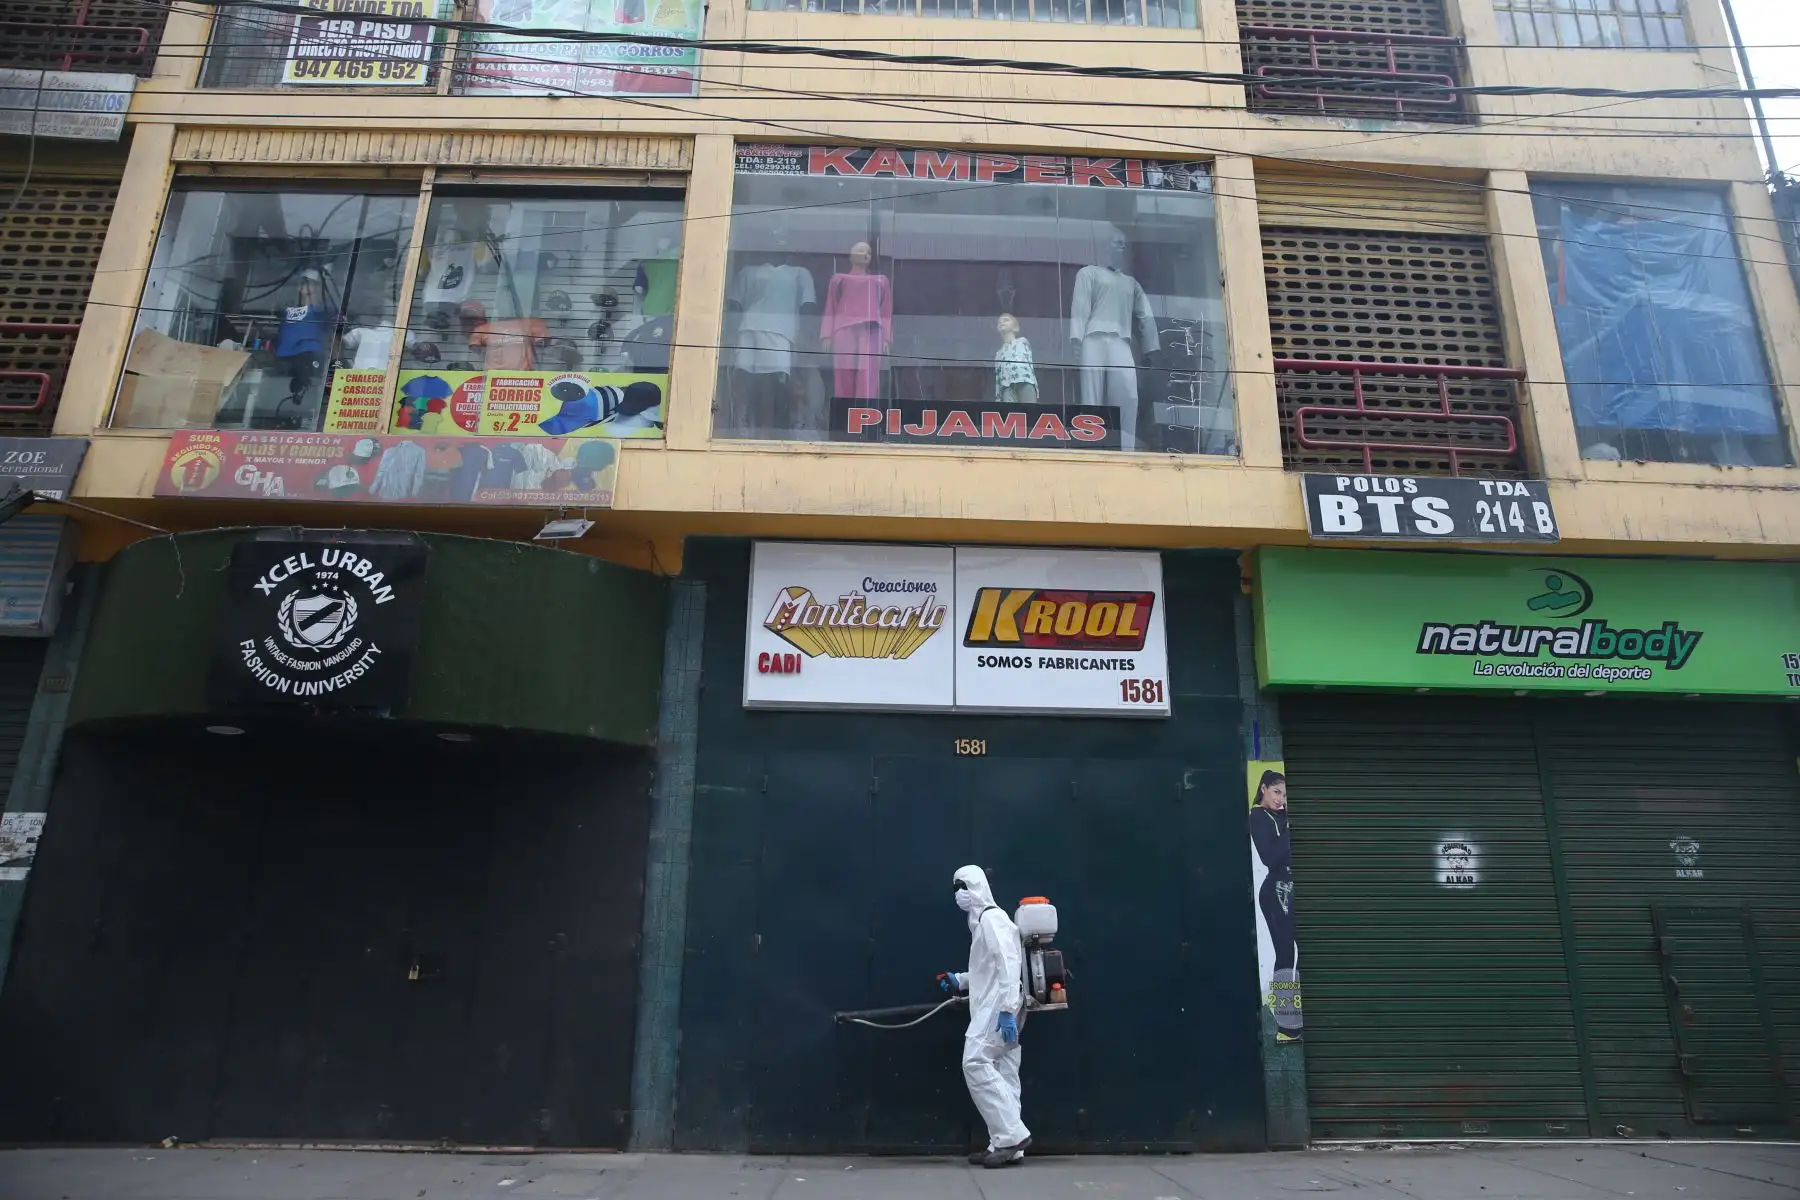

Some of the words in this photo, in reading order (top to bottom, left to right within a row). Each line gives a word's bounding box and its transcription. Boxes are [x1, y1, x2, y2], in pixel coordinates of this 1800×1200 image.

[333, 0, 386, 14] VENDE
[318, 20, 356, 38] 1ER
[298, 38, 346, 58] DIRECTO
[348, 40, 422, 59] PROPIETARIO
[616, 44, 685, 58] GORROS
[294, 60, 331, 78] 947
[334, 61, 374, 79] 465
[379, 62, 418, 80] 952
[766, 157, 798, 165] B-219
[808, 145, 1146, 189] KAMPEKI
[345, 374, 387, 383] CHALECO
[495, 378, 540, 387] FABRICACIÓN
[343, 385, 384, 395] CASACAS
[466, 392, 483, 403] PO
[489, 388, 541, 402] GORROS
[340, 398, 381, 407] CAMISAS
[488, 403, 539, 412] PUBLICITARIOS
[847, 407, 1107, 442] PIJAMAS
[188, 434, 221, 443] SUBA
[240, 435, 342, 446] FABRICACIÓN
[4, 451, 47, 464] ZOE
[170, 443, 212, 462] SEGUNDO
[233, 443, 277, 456] POLOS
[254, 456, 285, 464] MAYOR
[295, 457, 328, 465] MENOR
[234, 464, 285, 497] GHA
[1336, 476, 1418, 494] POLOS
[1479, 480, 1530, 497] TDA
[1318, 494, 1455, 535] BTS
[1475, 500, 1525, 534] 214
[1532, 500, 1555, 534] B
[253, 552, 316, 597] XCEL
[321, 548, 396, 605] URBAN
[315, 571, 339, 580] 1974
[861, 576, 938, 593] Creaciones
[764, 585, 948, 630] Montecarlo
[968, 588, 1141, 642] KROOL
[263, 635, 290, 664] VINTAGE
[285, 657, 321, 671] FASHION
[322, 637, 363, 668] VANGUARD
[1781, 653, 1800, 670] 15
[240, 638, 292, 693] FASHION
[293, 642, 383, 696] UNIVERSITY
[757, 652, 802, 674] CADI
[977, 655, 1033, 669] SOMOS
[1038, 656, 1136, 672] FABRICANTES
[1474, 661, 1495, 676] La
[1496, 662, 1565, 678] evolución
[1567, 663, 1592, 679] del
[1593, 664, 1652, 683] deporte
[1119, 678, 1164, 704] 1581
[954, 739, 987, 755] 1581
[1446, 875, 1474, 885] ALKAR
[1268, 994, 1277, 1009] 2
